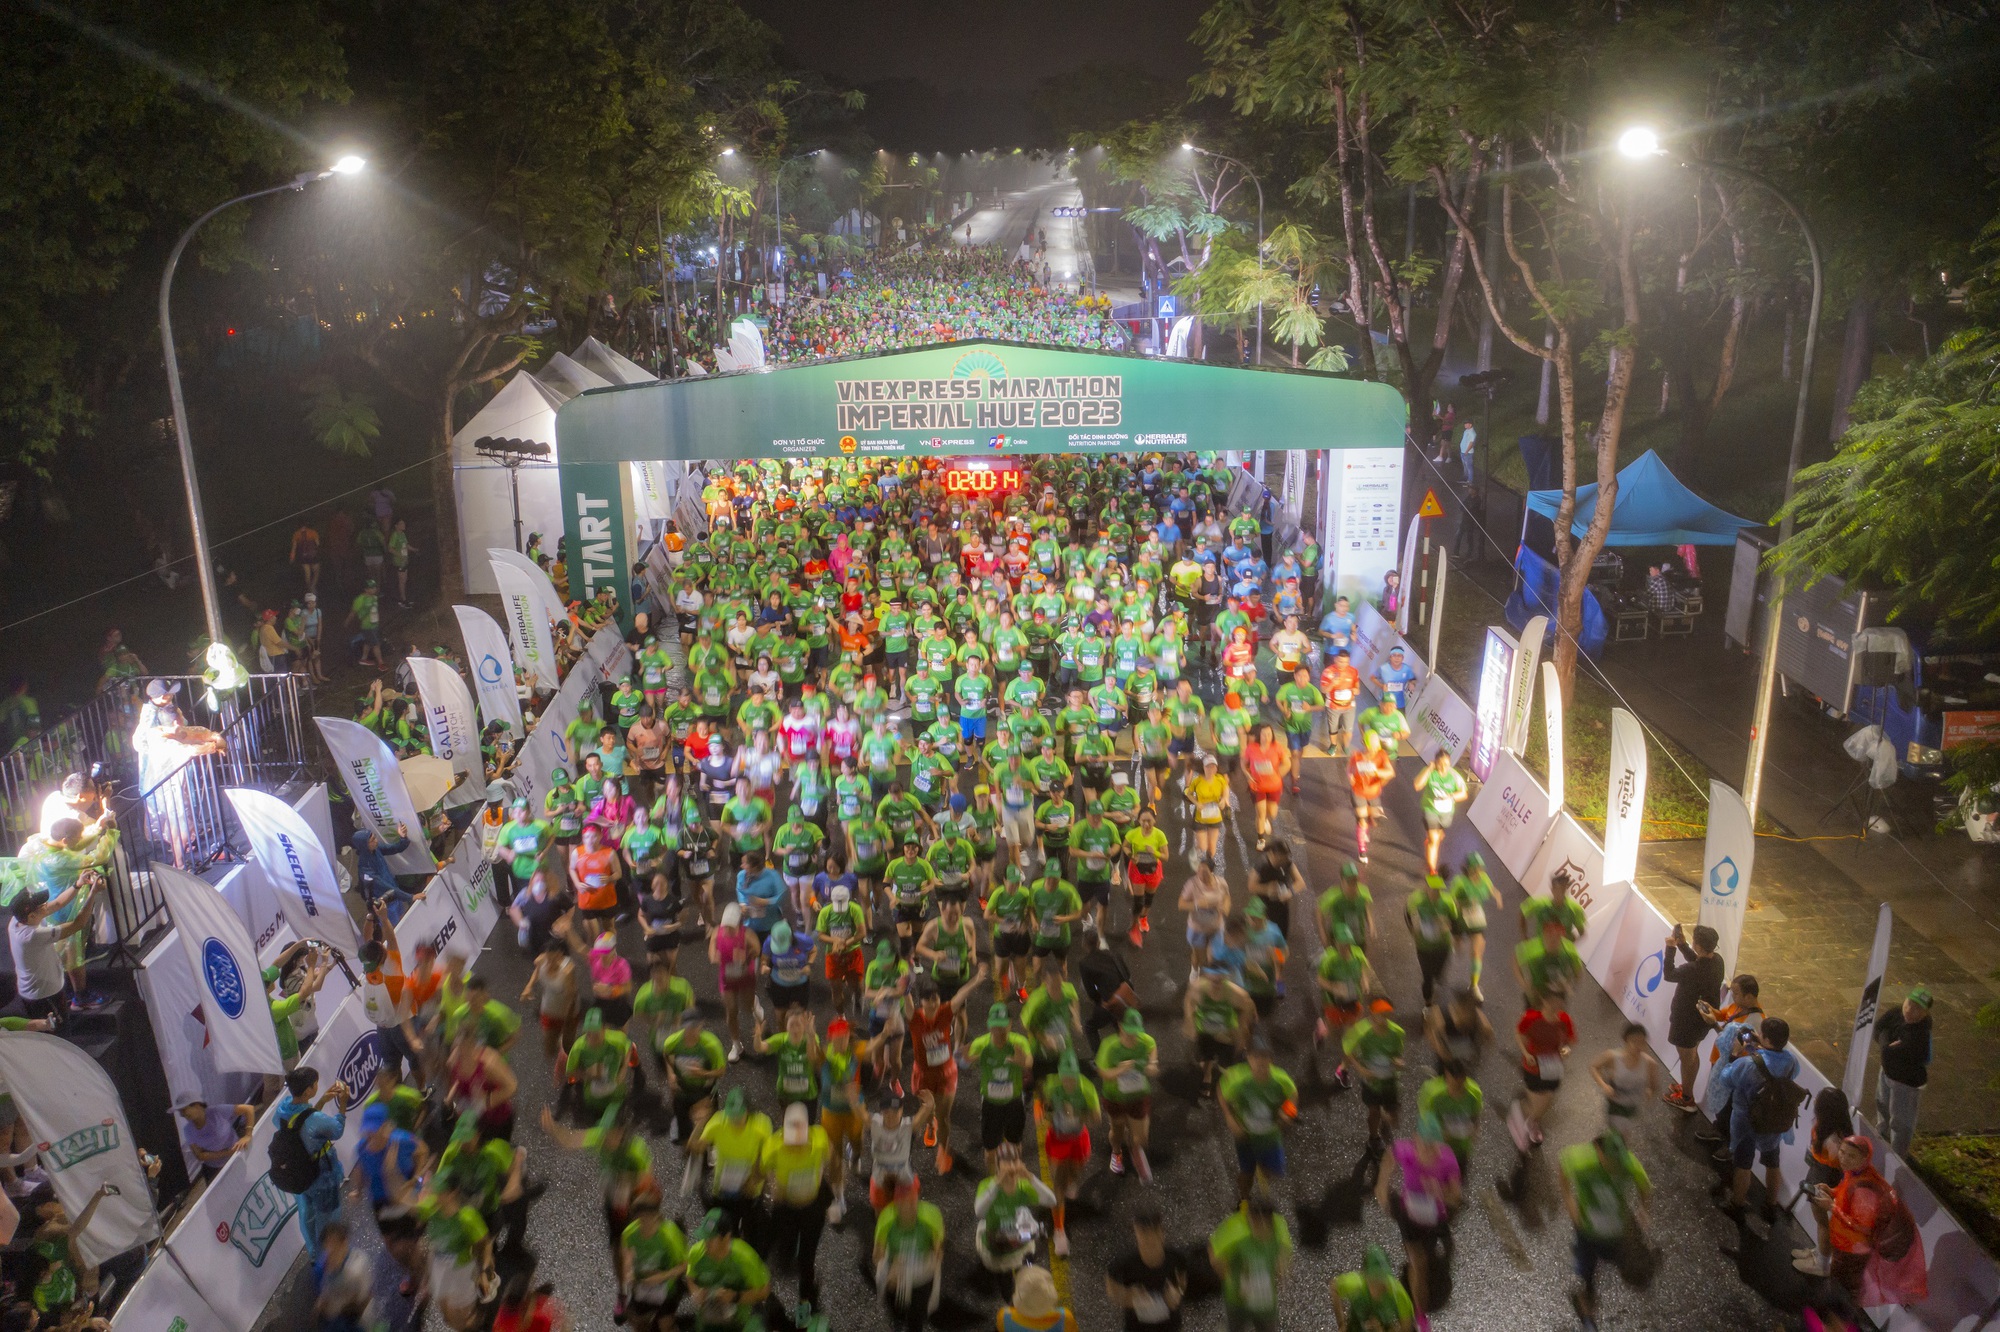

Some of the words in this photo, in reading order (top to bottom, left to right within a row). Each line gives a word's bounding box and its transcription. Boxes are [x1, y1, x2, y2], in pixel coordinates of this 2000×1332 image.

[835, 379, 981, 402] VNEXPRESS
[989, 376, 1122, 399] MARATHON
[837, 402, 972, 431] IMPERIAL
[977, 400, 1036, 429] HUE
[1041, 400, 1122, 428] 2023
[989, 435, 1012, 449] FPT
[512, 594, 530, 648] HERBALIFE
[521, 594, 537, 649] NUTRITION
[433, 705, 453, 760] GALLE
[449, 712, 462, 747] WATCH
[1428, 709, 1460, 748] HERBALIFE
[351, 760, 386, 827] HERBALIFE
[362, 757, 397, 827] NUTRITION
[1502, 786, 1532, 824] GALLE
[276, 832, 319, 918] SKECHERS
[344, 1043, 378, 1100] Ford
